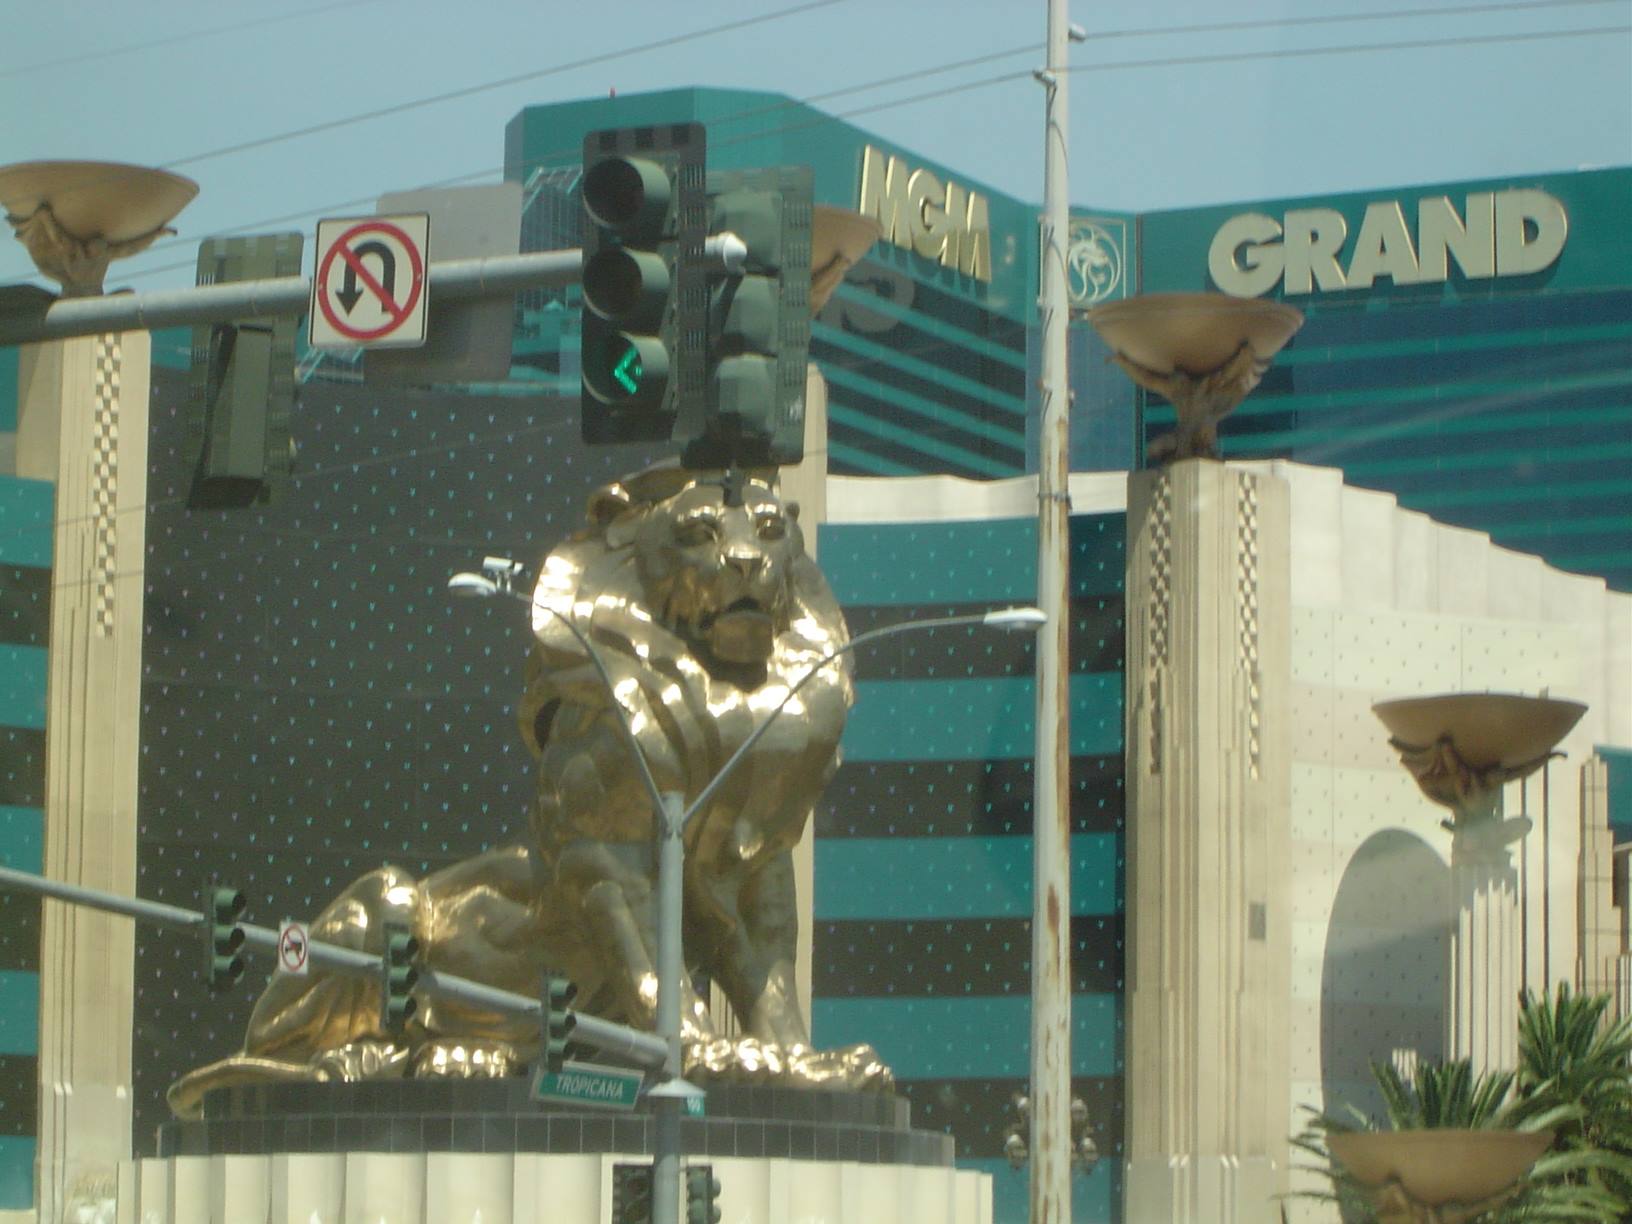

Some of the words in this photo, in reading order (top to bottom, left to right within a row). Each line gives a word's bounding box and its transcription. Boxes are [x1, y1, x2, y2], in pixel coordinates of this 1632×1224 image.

[859, 144, 992, 284] MGM
[1208, 188, 1568, 298] GRAND
[556, 1074, 624, 1099] TROPICANA
